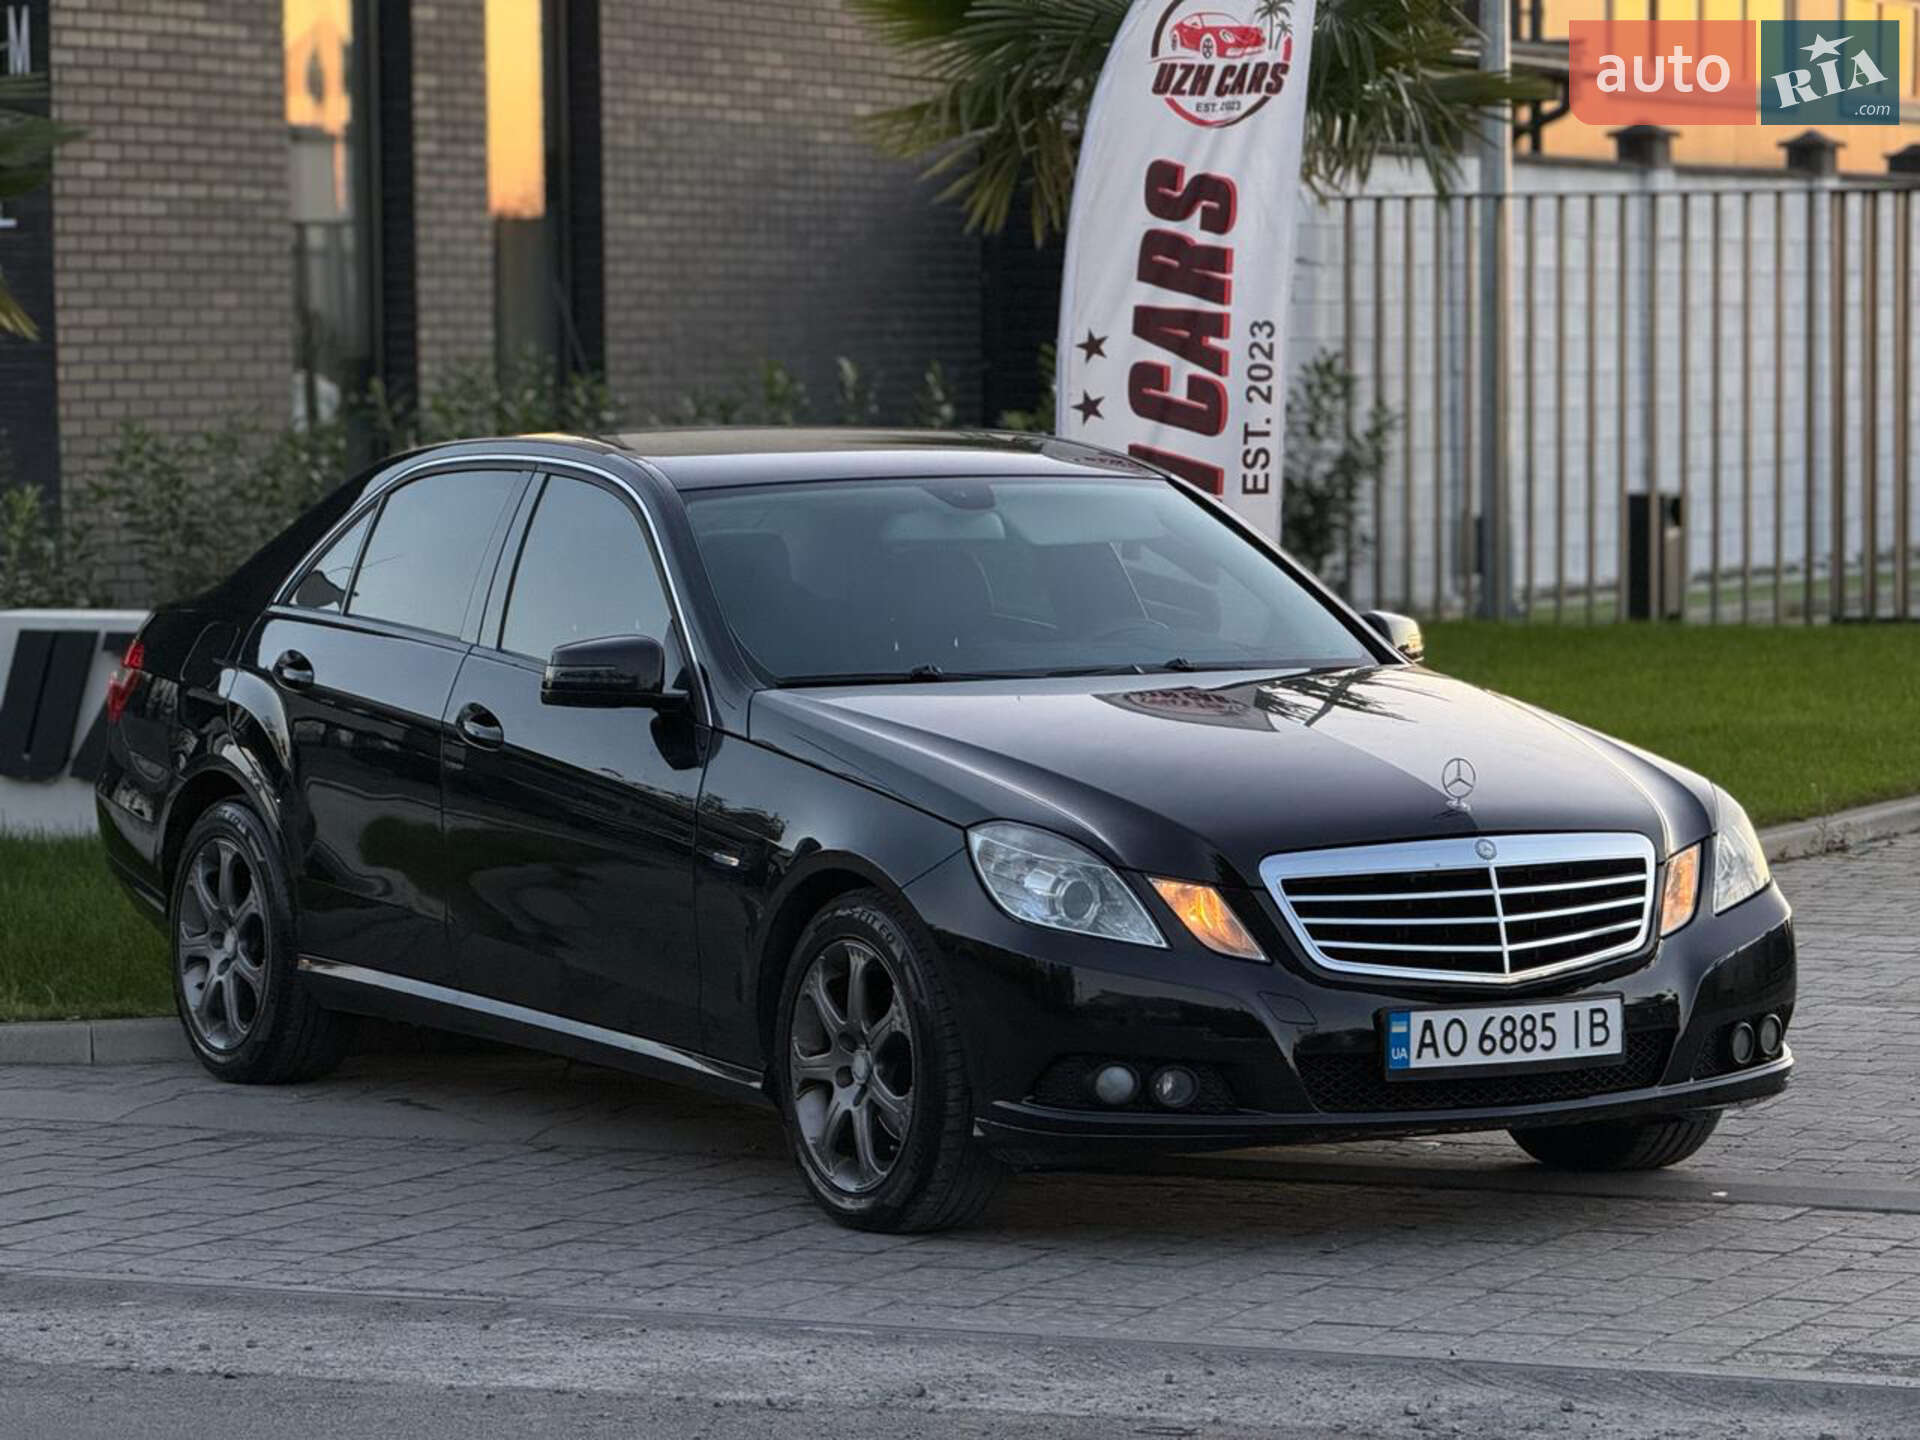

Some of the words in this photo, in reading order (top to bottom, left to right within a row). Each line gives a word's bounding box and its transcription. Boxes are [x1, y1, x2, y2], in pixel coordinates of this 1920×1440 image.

[1152, 62, 1215, 97] UZH
[1214, 62, 1290, 98] CARS
[1128, 158, 1238, 438] CARS
[1246, 319, 1276, 405] 2023
[1242, 417, 1272, 496] EST.
[1391, 1047, 1408, 1060] UA
[1416, 1017, 1468, 1059] AO
[1478, 1011, 1557, 1056] 6885
[1574, 1007, 1611, 1049] IB
